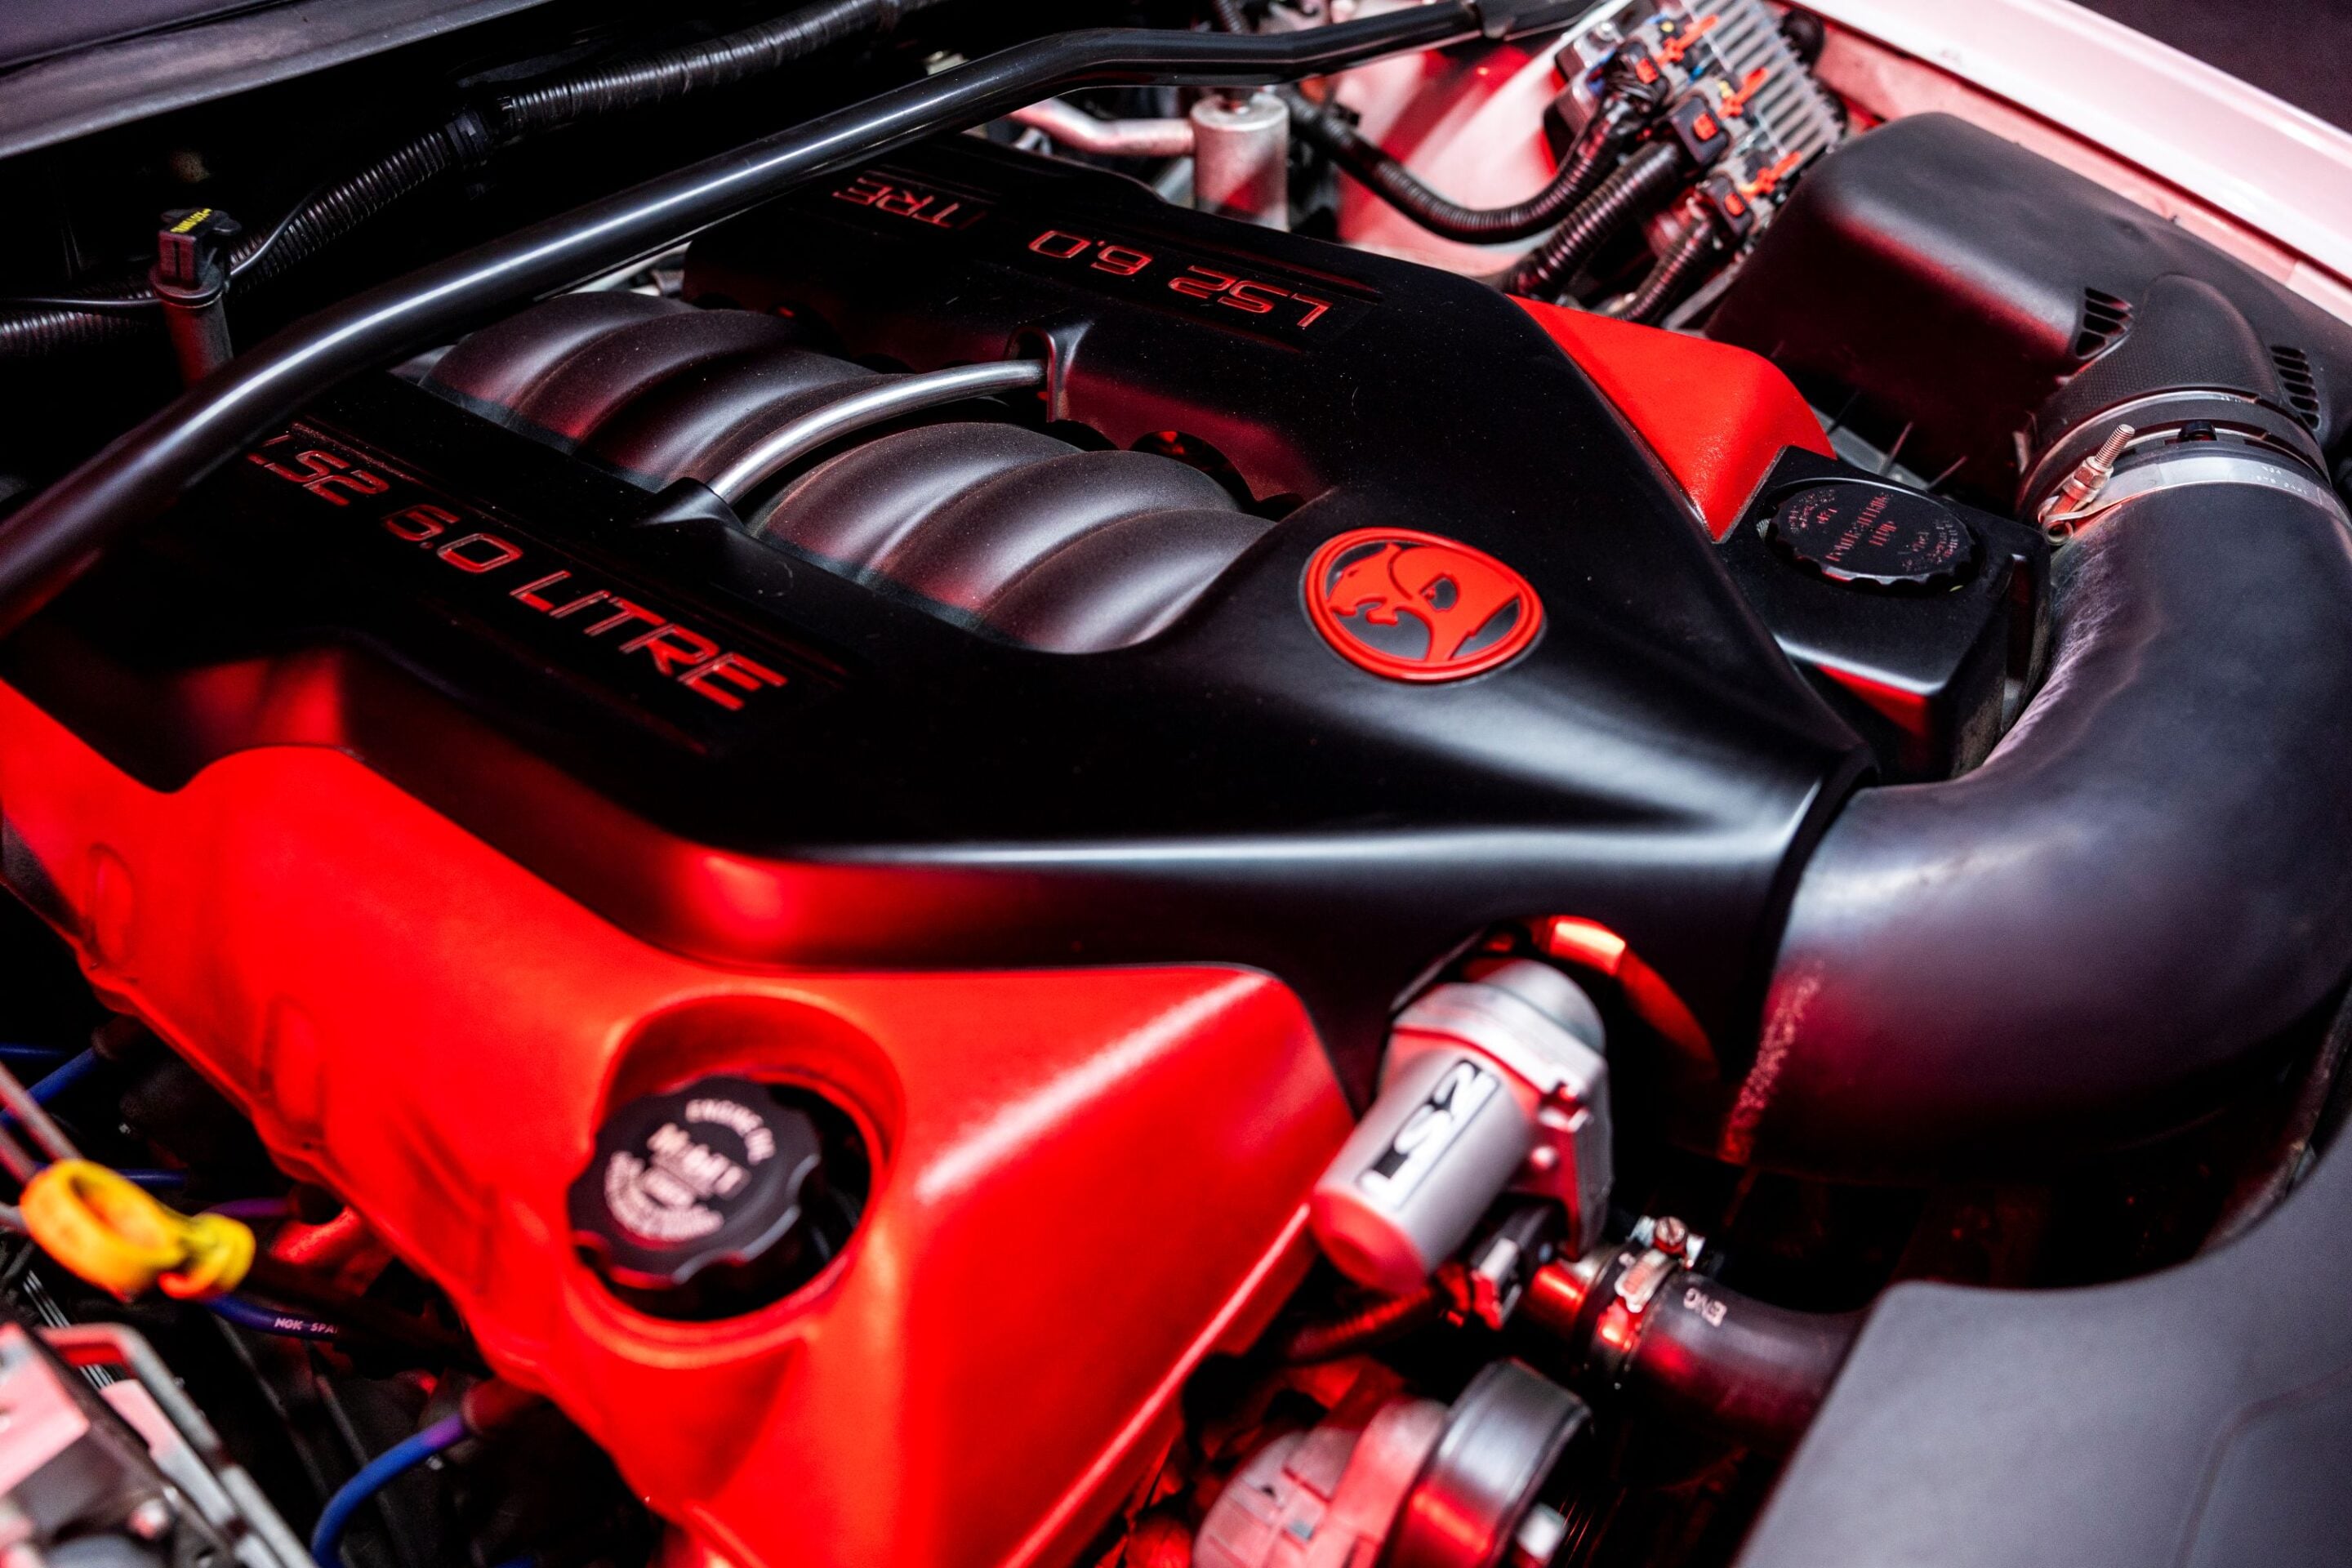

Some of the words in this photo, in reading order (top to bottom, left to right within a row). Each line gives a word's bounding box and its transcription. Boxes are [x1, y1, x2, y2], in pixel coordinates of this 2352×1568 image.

[1029, 230, 1154, 276] 6.0
[1168, 265, 1334, 327] LS2
[247, 434, 390, 506] LS2
[381, 504, 523, 573] 6.0
[510, 570, 789, 712] LITRE
[1357, 1061, 1499, 1212] LS2
